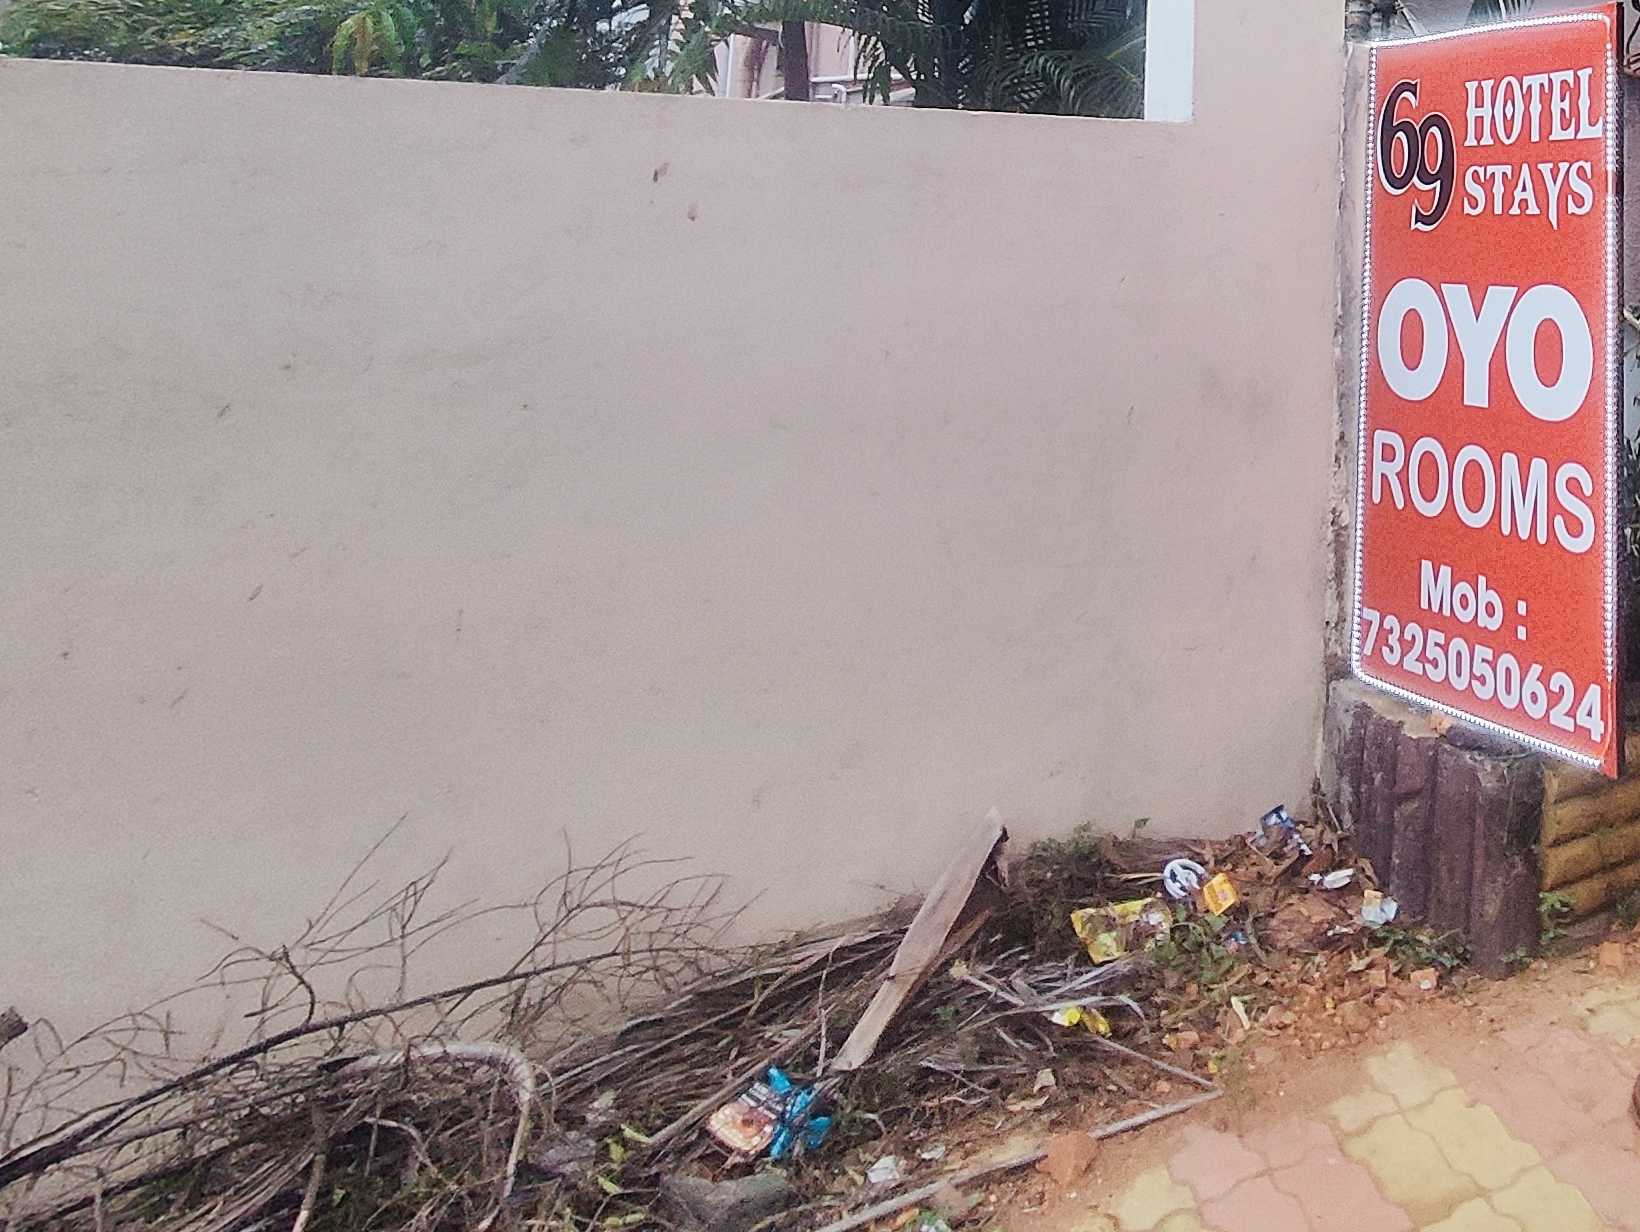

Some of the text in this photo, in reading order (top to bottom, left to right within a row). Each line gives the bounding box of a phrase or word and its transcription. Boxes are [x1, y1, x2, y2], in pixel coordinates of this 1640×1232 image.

[1376, 78, 1457, 231] 69
[1463, 67, 1602, 147] HOTEL
[1463, 160, 1594, 231] STAYS
[1377, 277, 1594, 422] OYO
[1372, 429, 1595, 553] ROOMS
[1361, 607, 1605, 743] 7325050624
